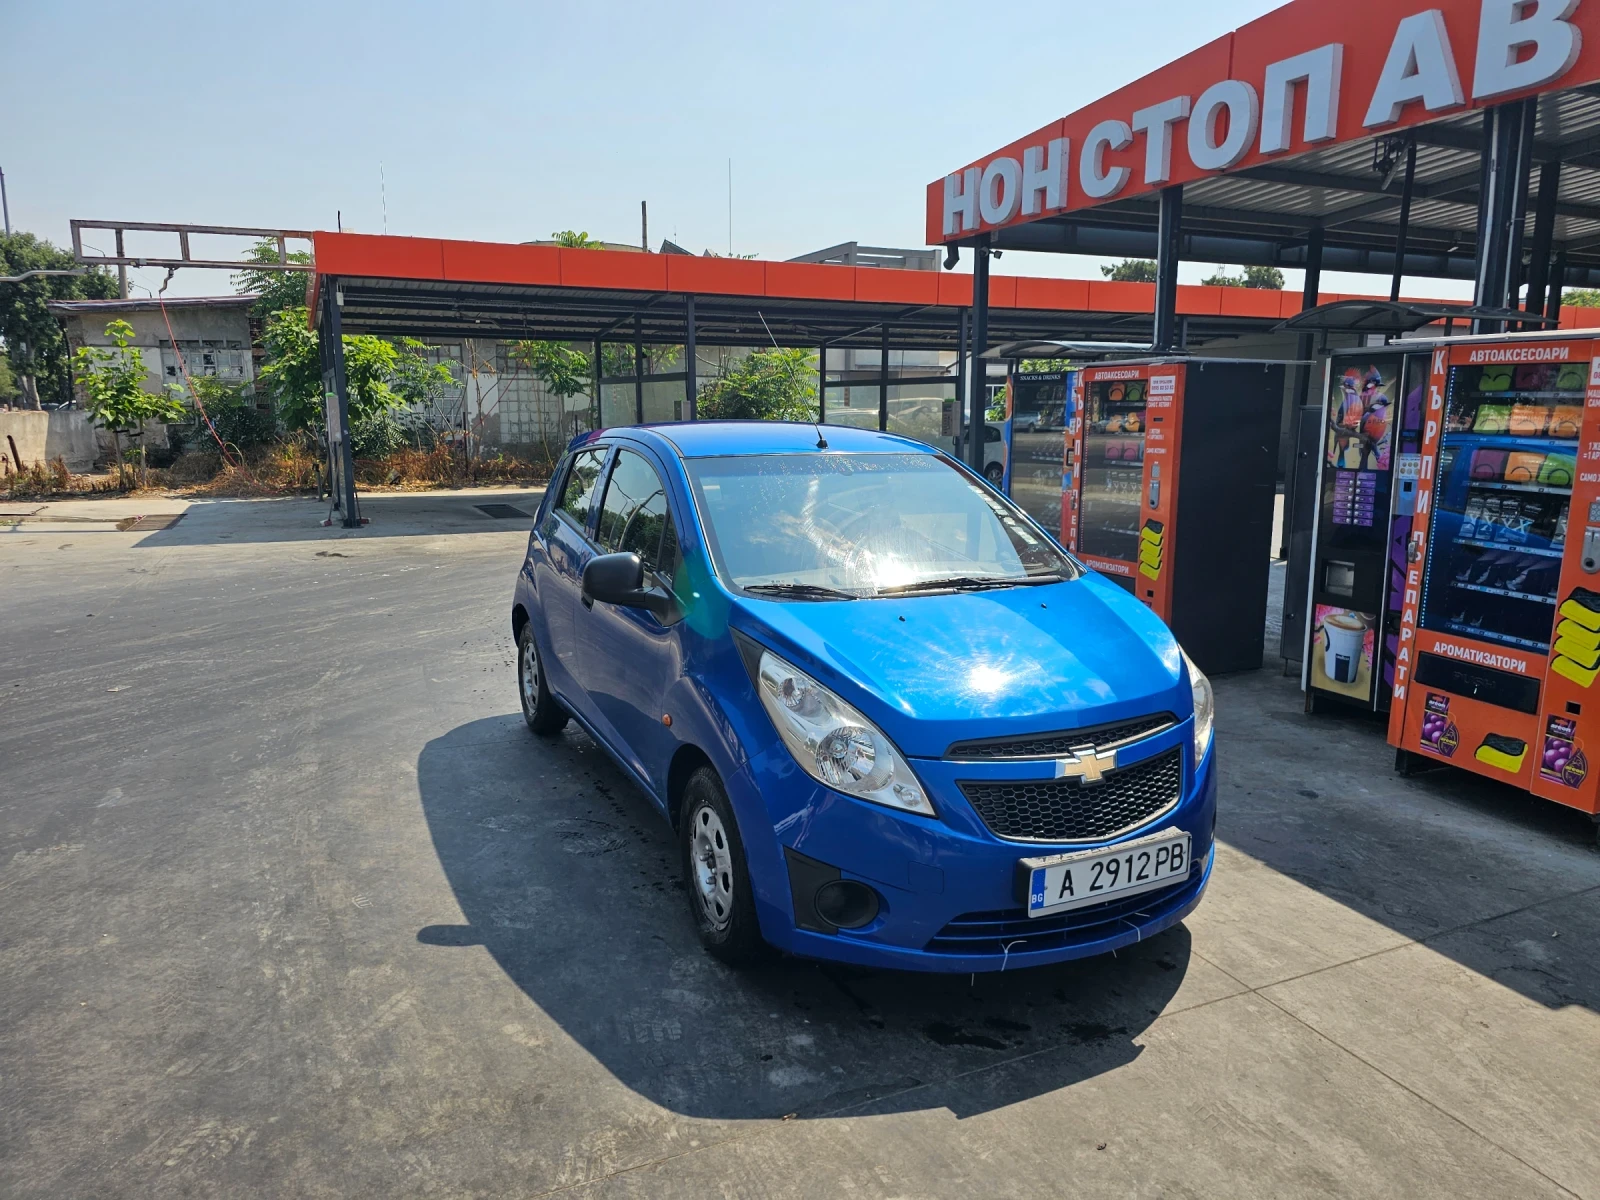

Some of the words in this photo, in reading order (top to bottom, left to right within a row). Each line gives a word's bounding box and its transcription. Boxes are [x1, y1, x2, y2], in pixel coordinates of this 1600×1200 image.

[943, 137, 1069, 237] НОН
[1079, 42, 1343, 199] СТОП
[1469, 347, 1570, 363] АВТОАКСЕСОАРИ
[1094, 369, 1140, 380] АВТОАКСЕСОАРИ
[1417, 350, 1445, 514] КЪРПИ
[1086, 560, 1129, 574] АРОМАТИЗАТОРИ
[1433, 641, 1527, 673] АРОМАТИЗАТОРИ
[1059, 869, 1075, 899] A
[1031, 893, 1044, 904] BG
